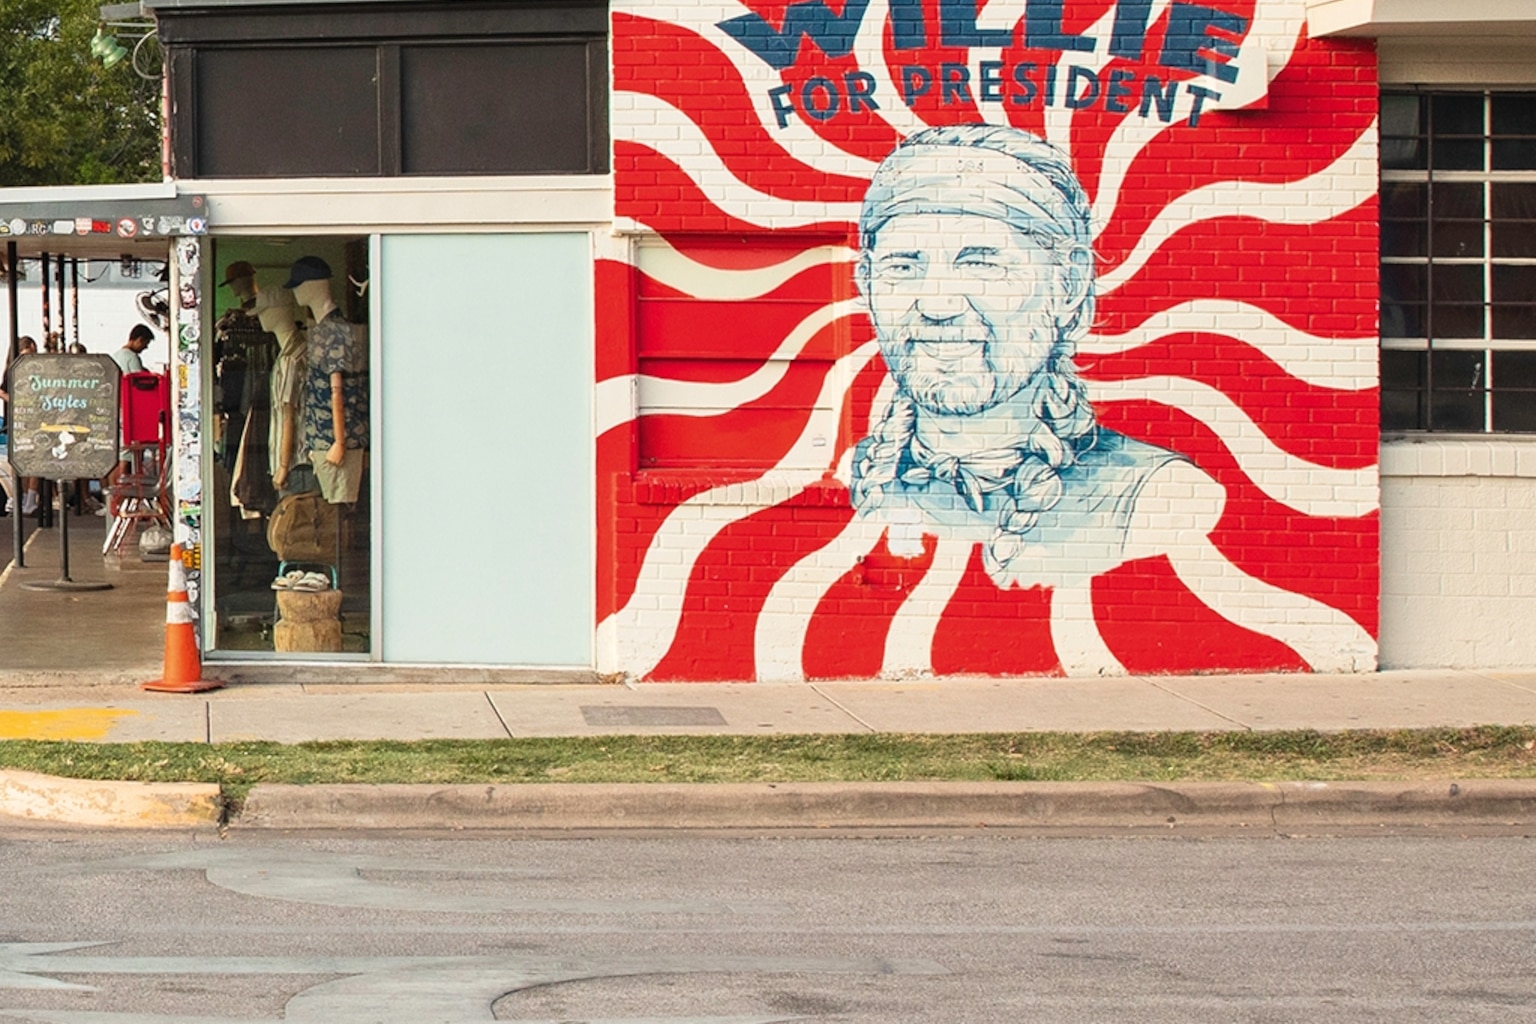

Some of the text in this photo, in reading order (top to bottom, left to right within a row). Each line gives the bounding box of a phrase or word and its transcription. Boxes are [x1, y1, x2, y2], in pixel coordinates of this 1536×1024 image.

[767, 60, 1221, 129] FOR PRESIDENT
[28, 374, 100, 392] Summer
[40, 395, 88, 412] Styles
